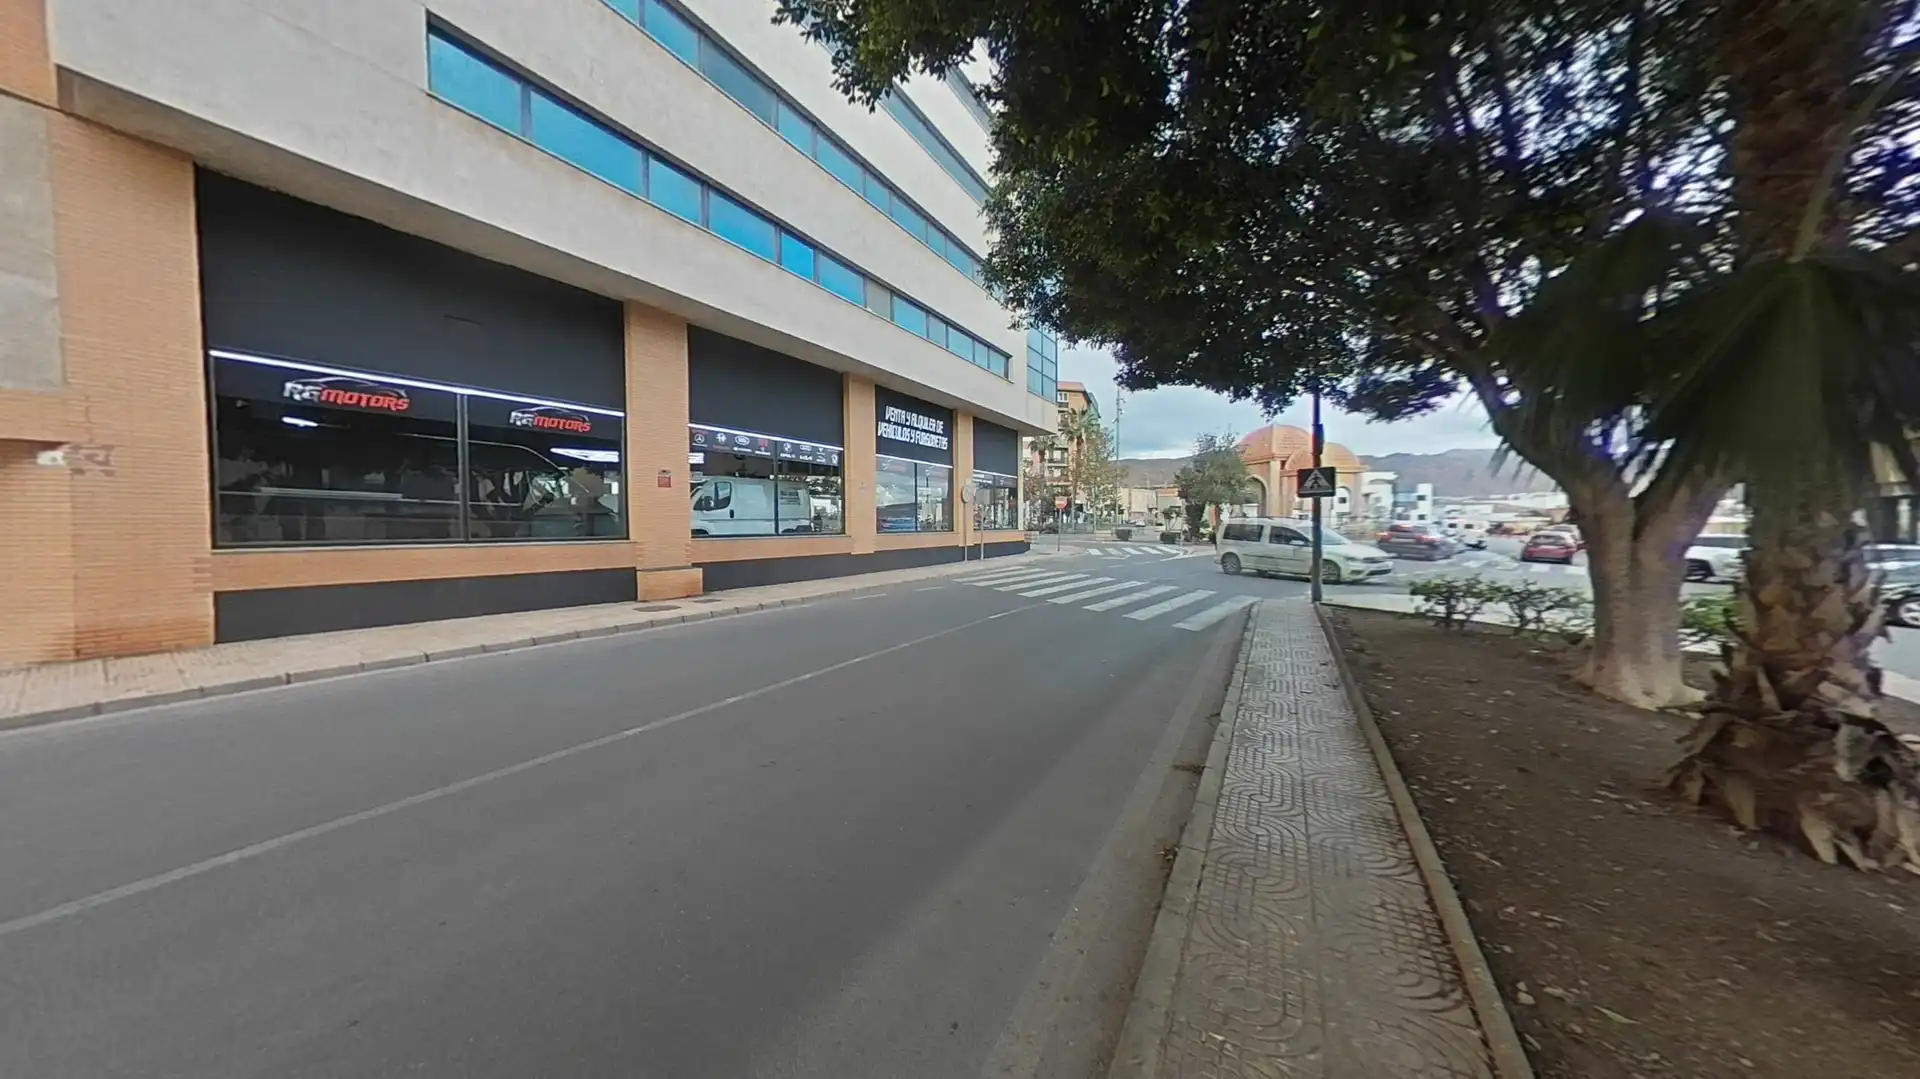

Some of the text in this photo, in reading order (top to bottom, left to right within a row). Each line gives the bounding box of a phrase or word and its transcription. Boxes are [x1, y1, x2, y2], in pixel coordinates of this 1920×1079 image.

[320, 389, 410, 411] MOTORS
[534, 416, 592, 433] MOTORS
[885, 405, 944, 434] VENTA Y ALQUILER DE
[911, 429, 916, 443] Y
